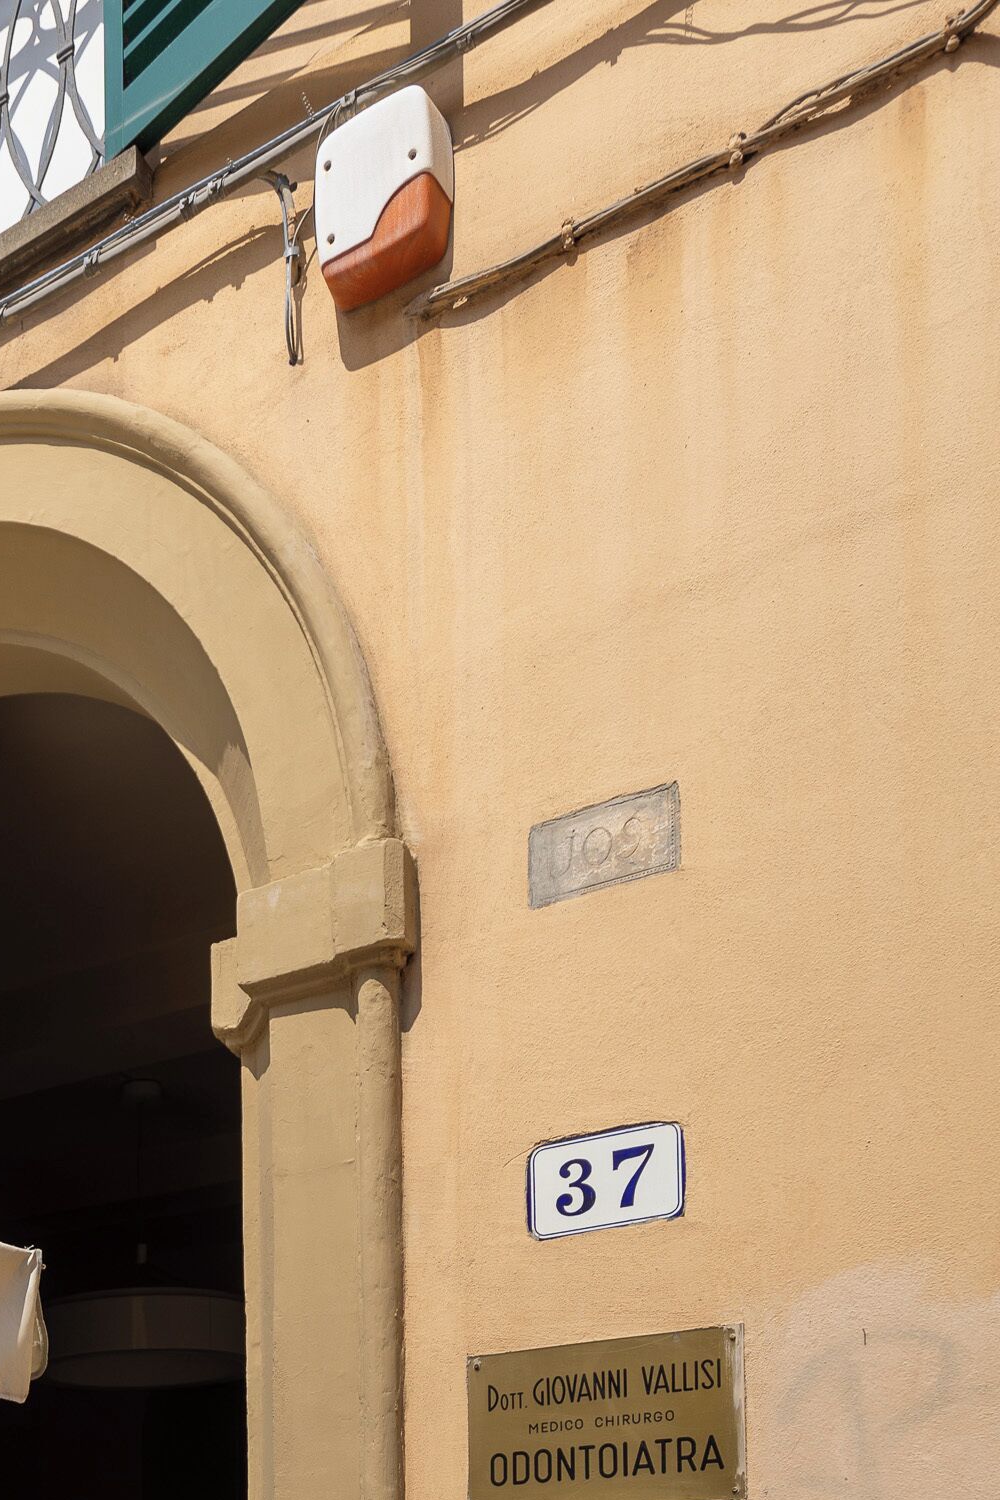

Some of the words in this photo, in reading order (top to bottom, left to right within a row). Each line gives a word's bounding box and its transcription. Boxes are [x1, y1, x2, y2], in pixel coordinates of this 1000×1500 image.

[555, 1143, 655, 1217] 37
[532, 1368, 628, 1407] GIOVANNI
[641, 1358, 722, 1396] VALLISI
[528, 1418, 585, 1435] MEDICO
[594, 1410, 676, 1429] CHIRURGO
[490, 1434, 725, 1487] ODONTOIATRA
